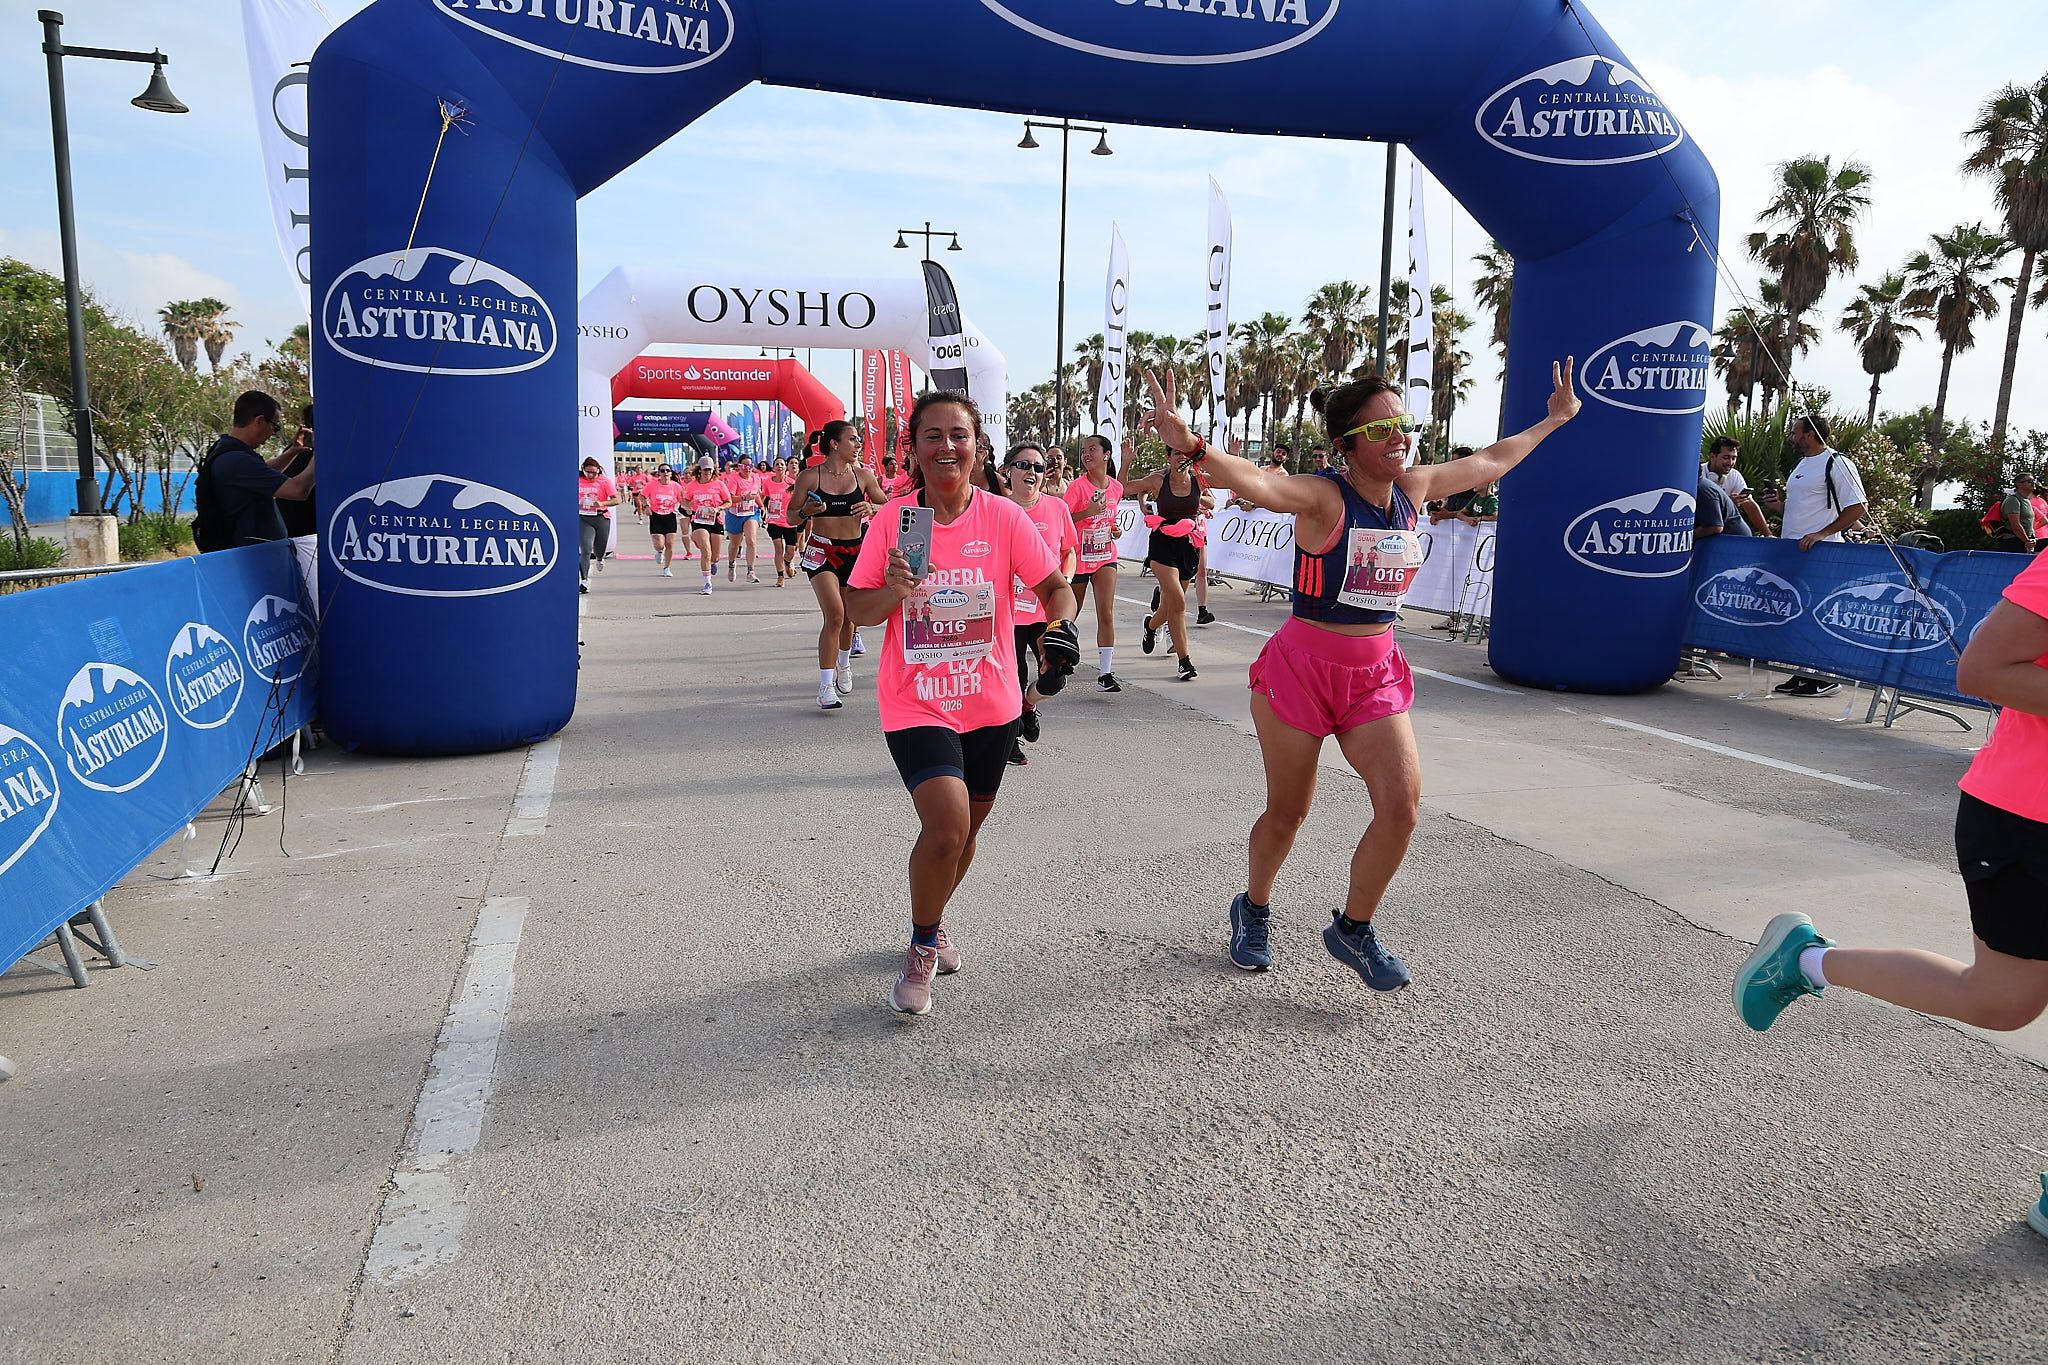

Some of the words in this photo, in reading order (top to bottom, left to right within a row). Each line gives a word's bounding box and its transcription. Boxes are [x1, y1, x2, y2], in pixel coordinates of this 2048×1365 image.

[1538, 92, 1609, 104] CENTRAL
[1493, 97, 1678, 137] ASTURIANA
[364, 288, 448, 304] CENTRAL
[458, 294, 538, 317] LECHERA
[687, 285, 876, 330] OYSHO
[333, 292, 545, 353] ASTURIANA
[1631, 353, 1687, 362] CENTRAL
[638, 366, 681, 382] Sports
[703, 368, 771, 381] Santander
[369, 514, 451, 528] CENTRAL
[461, 518, 540, 531] LECHERA
[1221, 517, 1293, 550] OYSHO
[1613, 519, 1669, 528] CENTRAL
[339, 516, 546, 566] ASTURIANA
[1375, 568, 1405, 582] 016
[932, 596, 967, 604] ASTURIANA
[1349, 595, 1377, 605] OYSHO
[1703, 583, 1791, 617] ASTURIANA
[932, 620, 967, 634] 016
[1822, 601, 1940, 641] ASTURIANA
[914, 652, 942, 660] OYSHO
[960, 649, 985, 657] Santander
[917, 672, 982, 701] MUJER
[79, 704, 114, 730] CENTRAL
[115, 688, 148, 712] LECHERA
[940, 699, 963, 712] 2026
[69, 703, 164, 776] ASTURIANA
